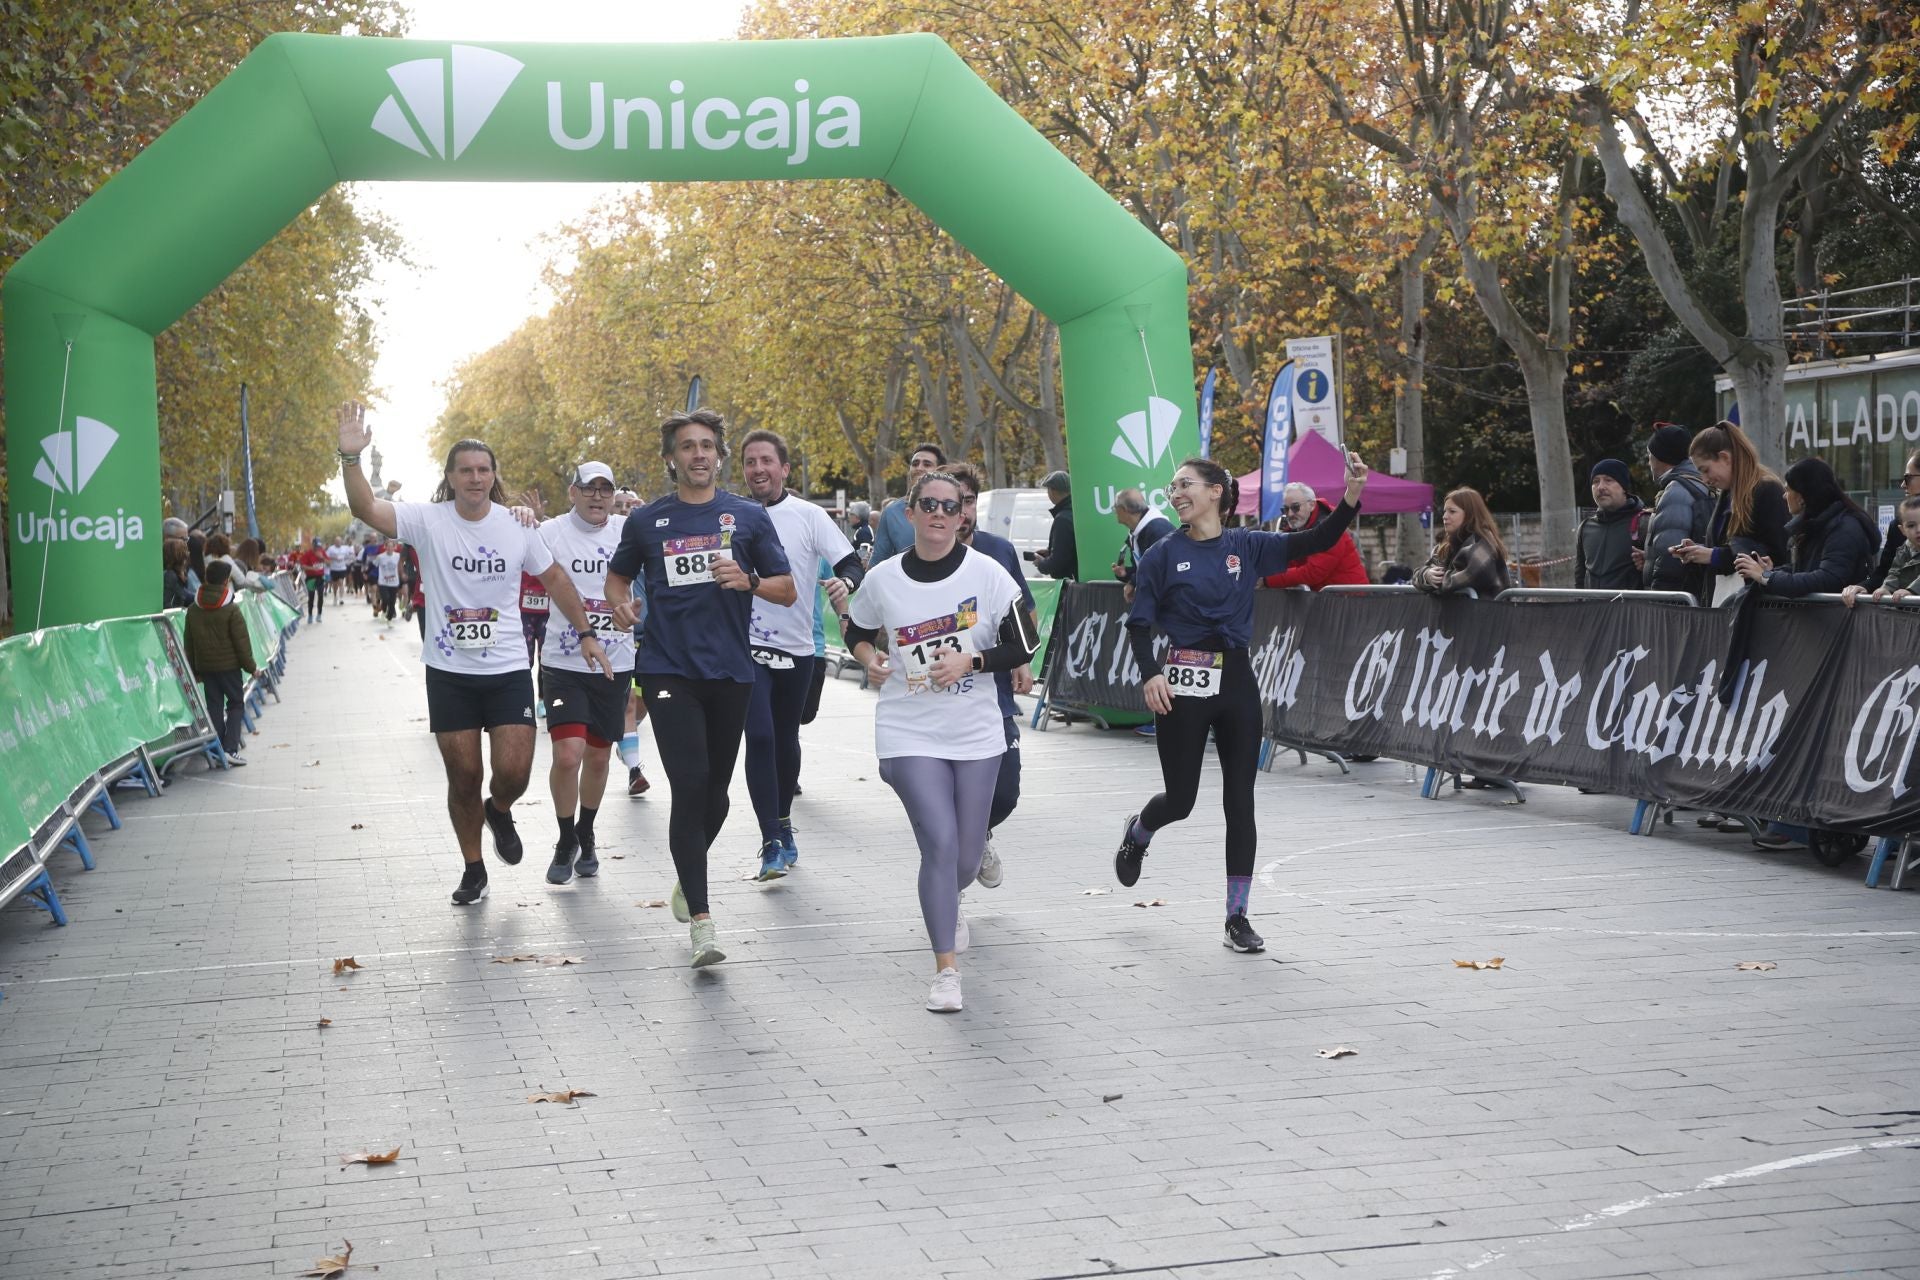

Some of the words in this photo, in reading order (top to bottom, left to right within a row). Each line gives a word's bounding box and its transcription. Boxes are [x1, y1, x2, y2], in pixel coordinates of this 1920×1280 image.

[547, 78, 861, 165] Unicaja
[1270, 395, 1290, 493] IVECO
[17, 508, 143, 550] Unicaja
[452, 555, 506, 574] curia
[526, 596, 545, 606] 391
[455, 623, 491, 641] 230
[589, 614, 617, 632] 22
[911, 636, 962, 665] 173
[1168, 666, 1210, 688] 883
[1344, 628, 1404, 721] El
[1401, 627, 1519, 740] Norte
[1522, 649, 1581, 746] de
[1586, 644, 1789, 773] Castilla
